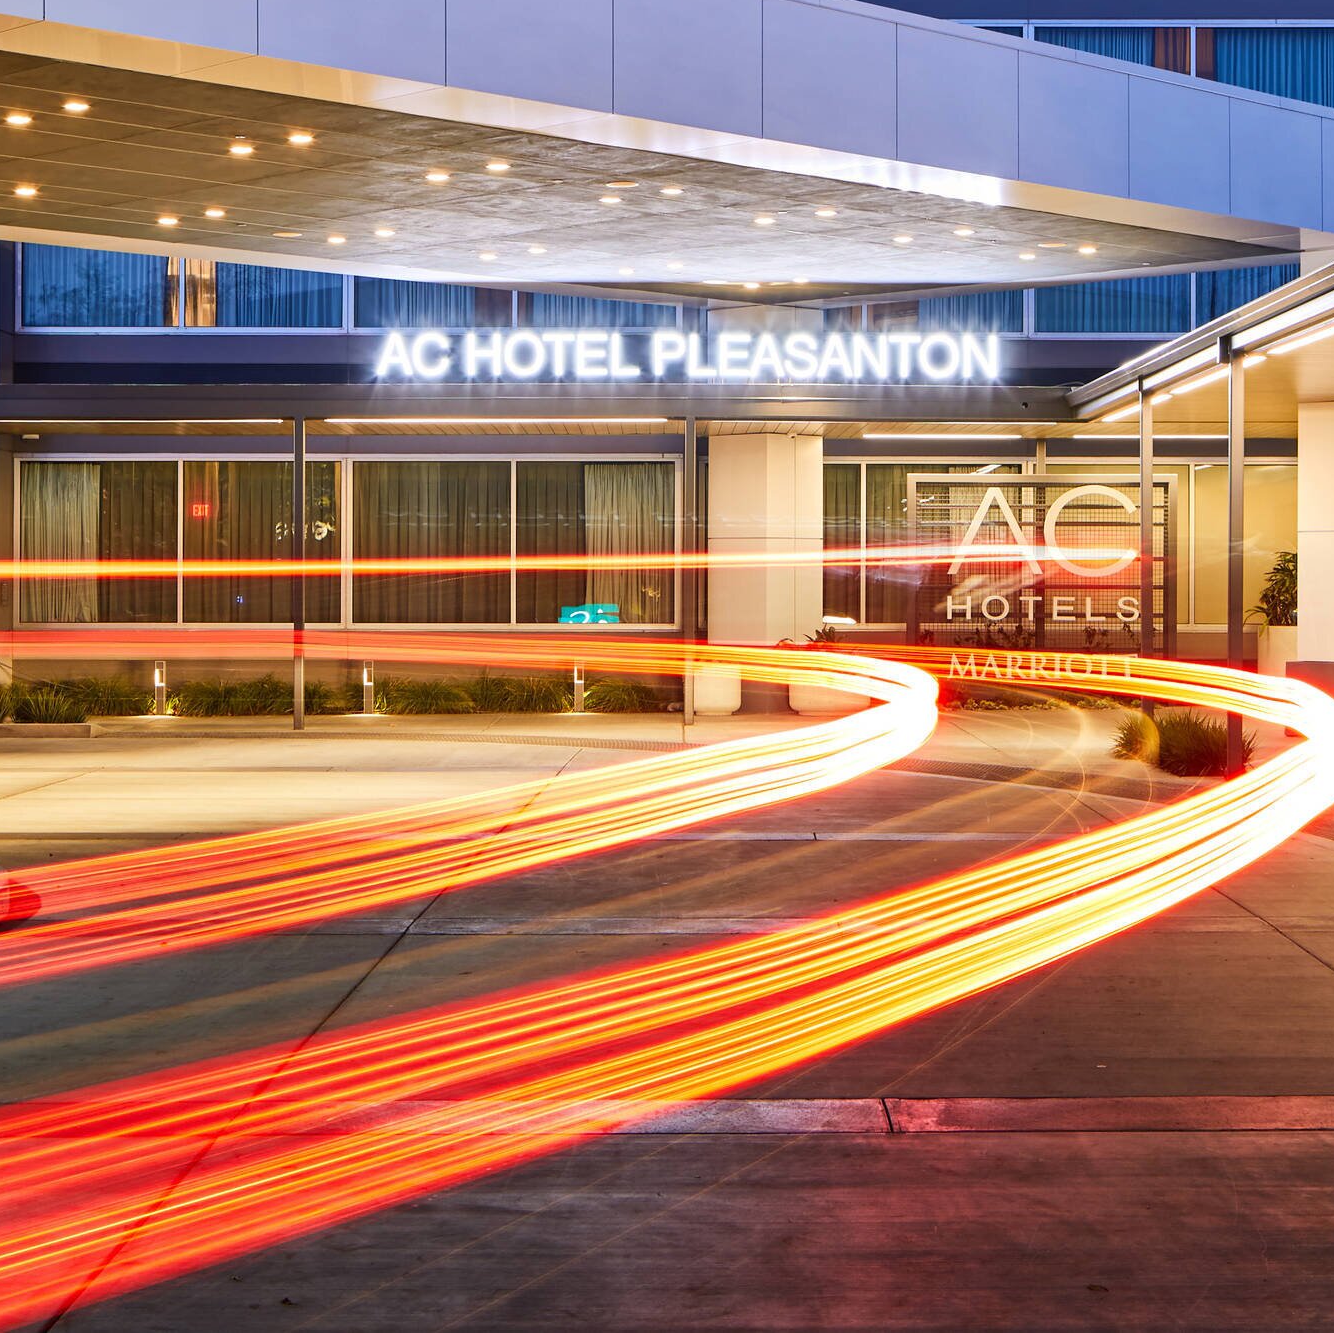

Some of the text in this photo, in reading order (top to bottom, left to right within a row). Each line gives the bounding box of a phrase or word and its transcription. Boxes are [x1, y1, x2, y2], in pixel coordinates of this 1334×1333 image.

[374, 331, 1000, 378] AC HOTEL PLEASANTON
[192, 504, 210, 517] EXIT
[947, 484, 1138, 577] AC
[946, 595, 1140, 622] HOTELS
[947, 652, 1139, 681] MARRIOTT
